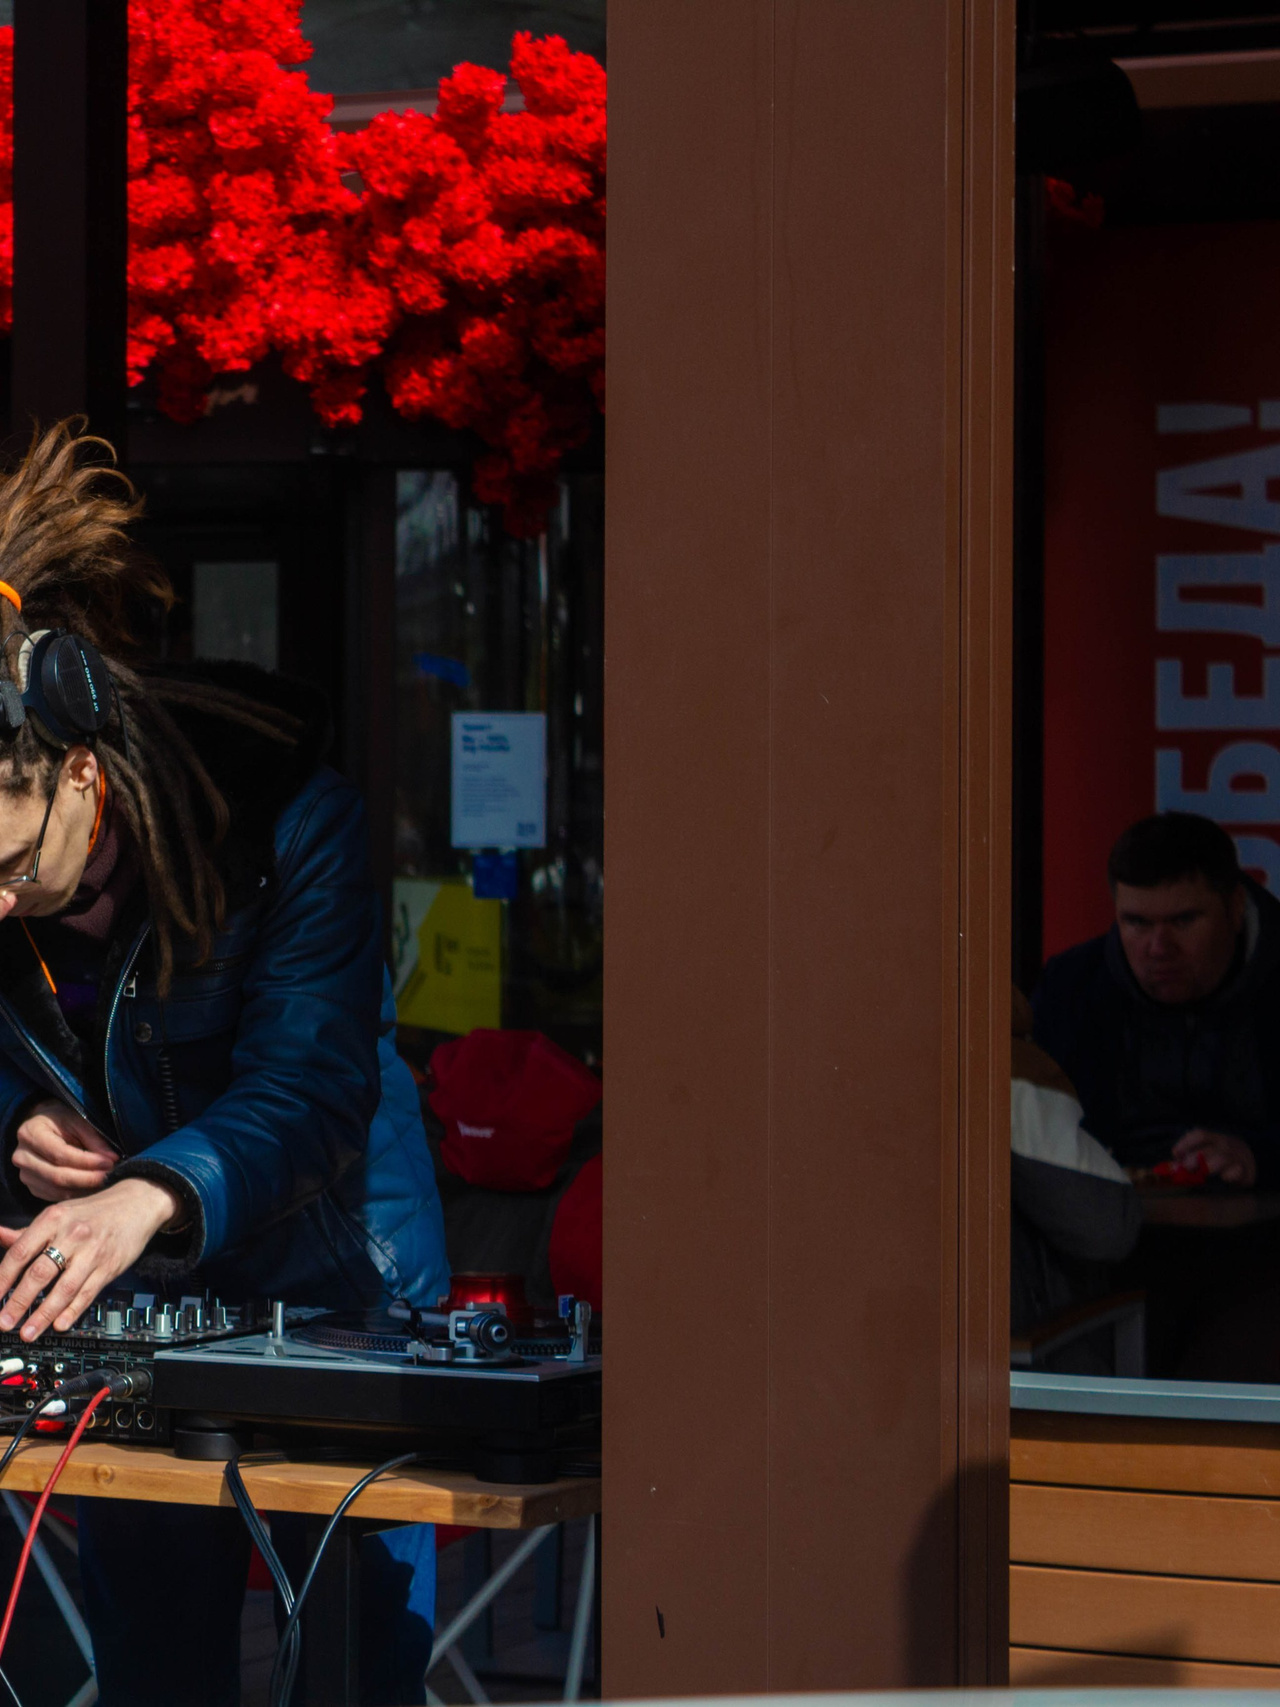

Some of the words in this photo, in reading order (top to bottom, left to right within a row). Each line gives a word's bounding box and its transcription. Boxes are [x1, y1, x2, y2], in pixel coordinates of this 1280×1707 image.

[1154, 402, 1280, 901] БЕДА!
[1, 1334, 42, 1346] DIGL
[44, 1336, 58, 1346] DJ
[61, 1337, 96, 1350] MIXER
